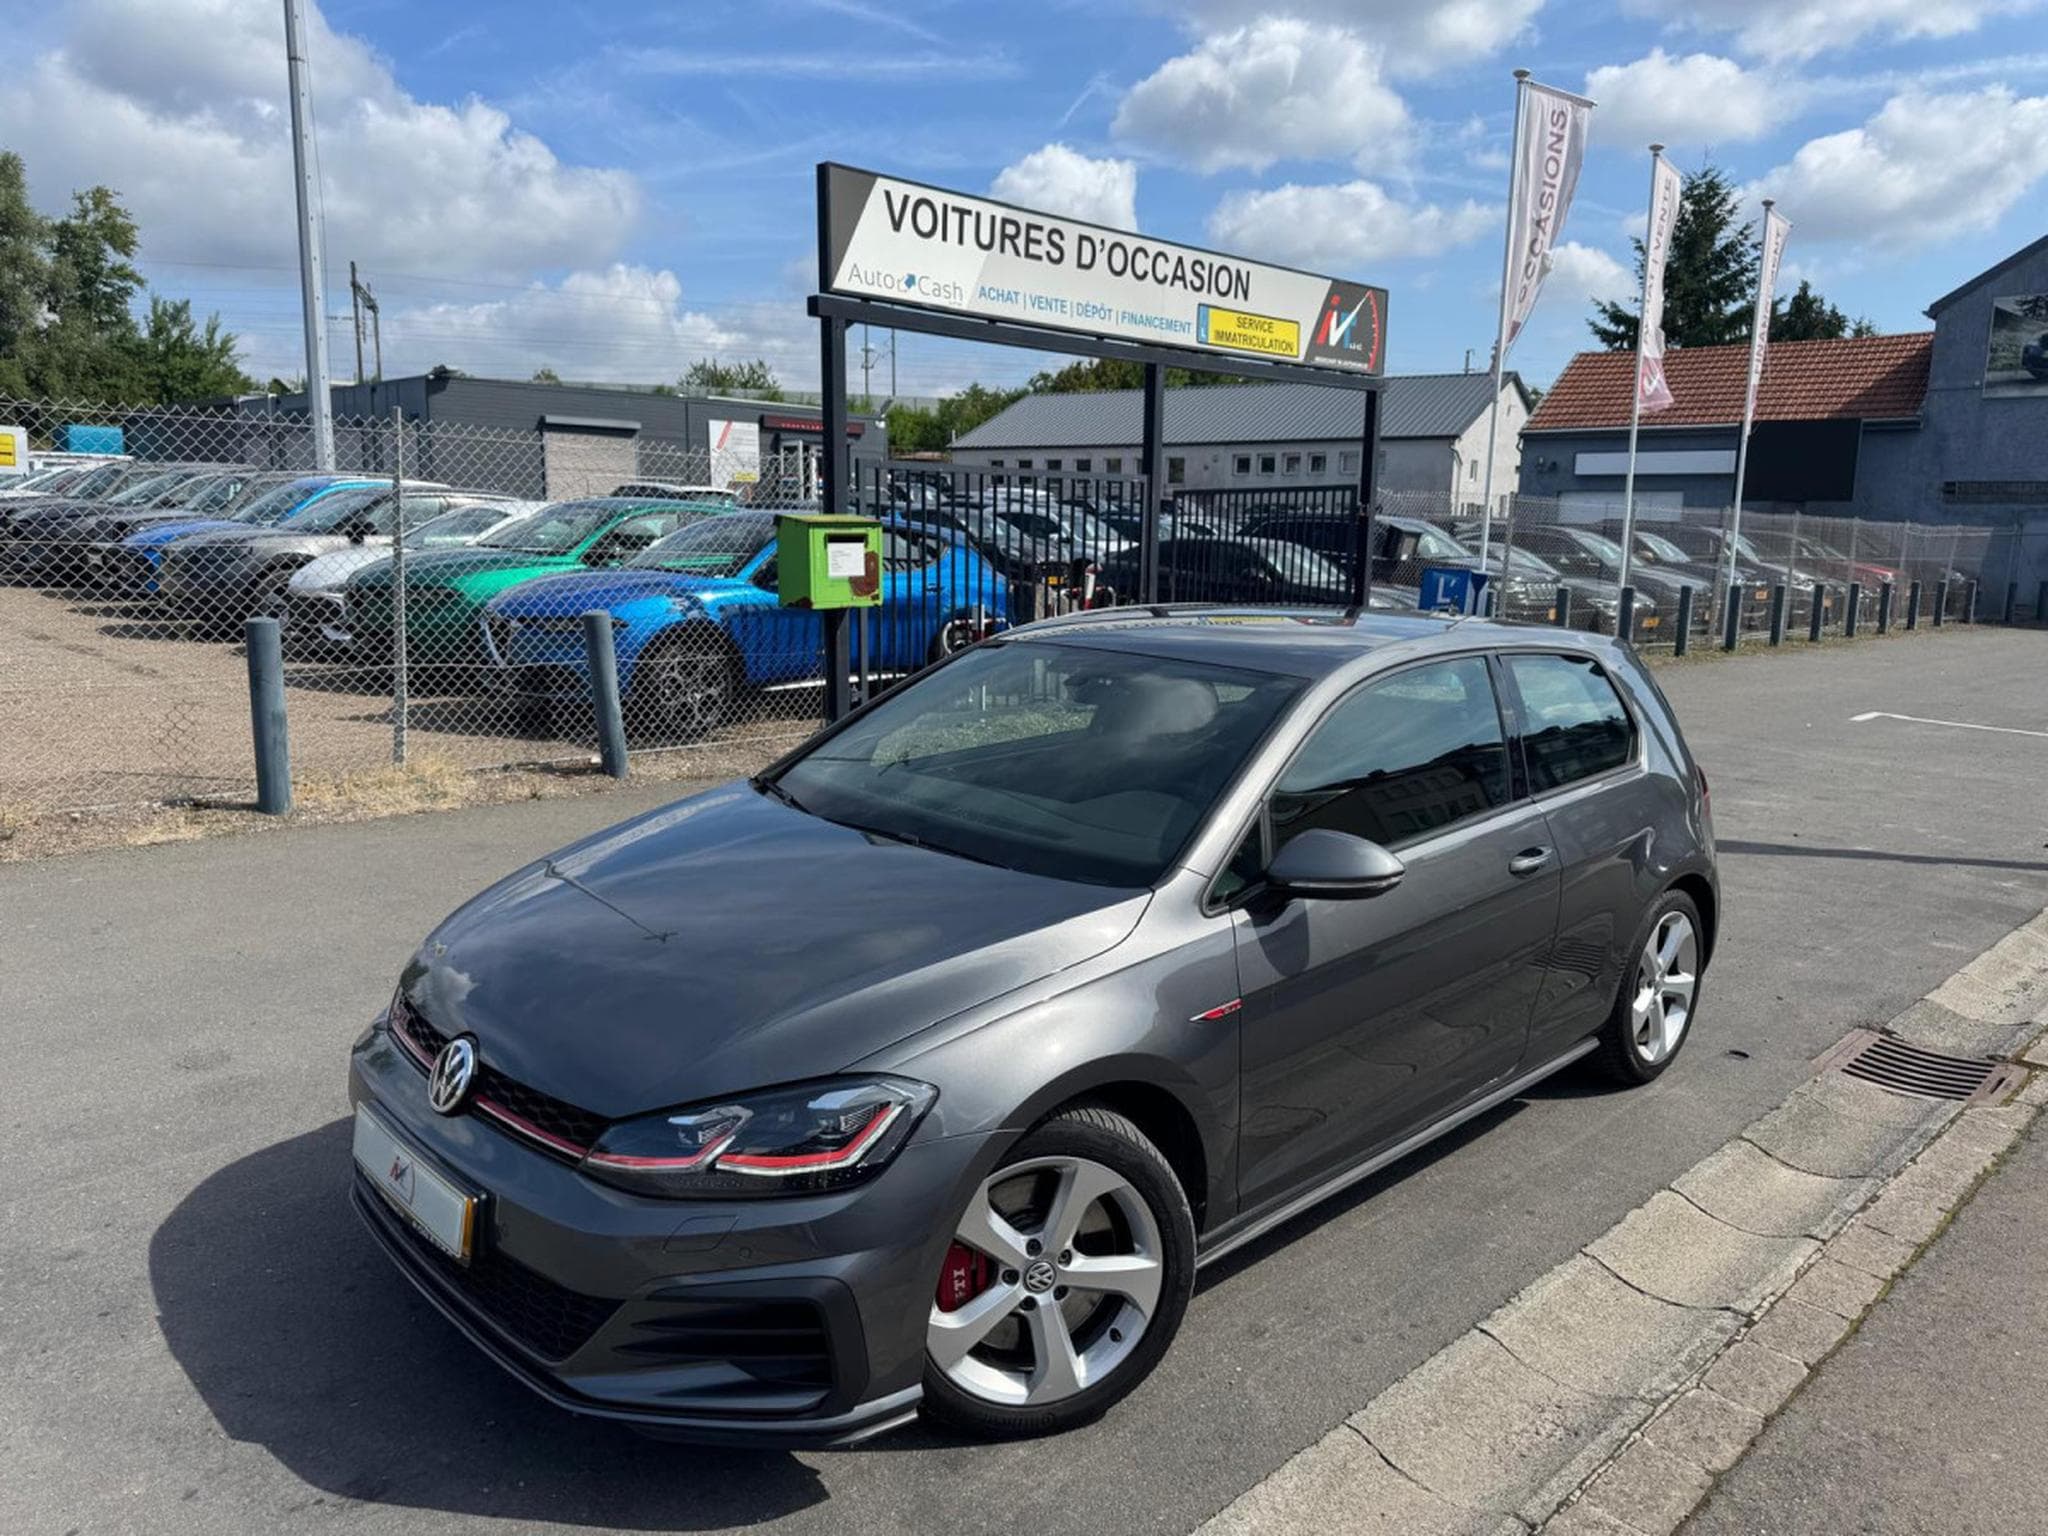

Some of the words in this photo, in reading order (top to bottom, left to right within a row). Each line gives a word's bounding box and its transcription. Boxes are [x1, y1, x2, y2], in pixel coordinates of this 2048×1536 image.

[884, 189, 1065, 266] VOITURES
[1076, 233, 1250, 301] D'OCCASION
[848, 263, 896, 289] Auto
[918, 275, 964, 302] Cash
[978, 286, 1020, 305] ACHAT
[1029, 294, 1067, 315] VENTE
[1076, 300, 1113, 322] DÉPÔT
[1120, 311, 1192, 335] FINANCEMENT
[1236, 315, 1275, 334] SERVICE
[1214, 330, 1294, 353] IMMATRICULATION
